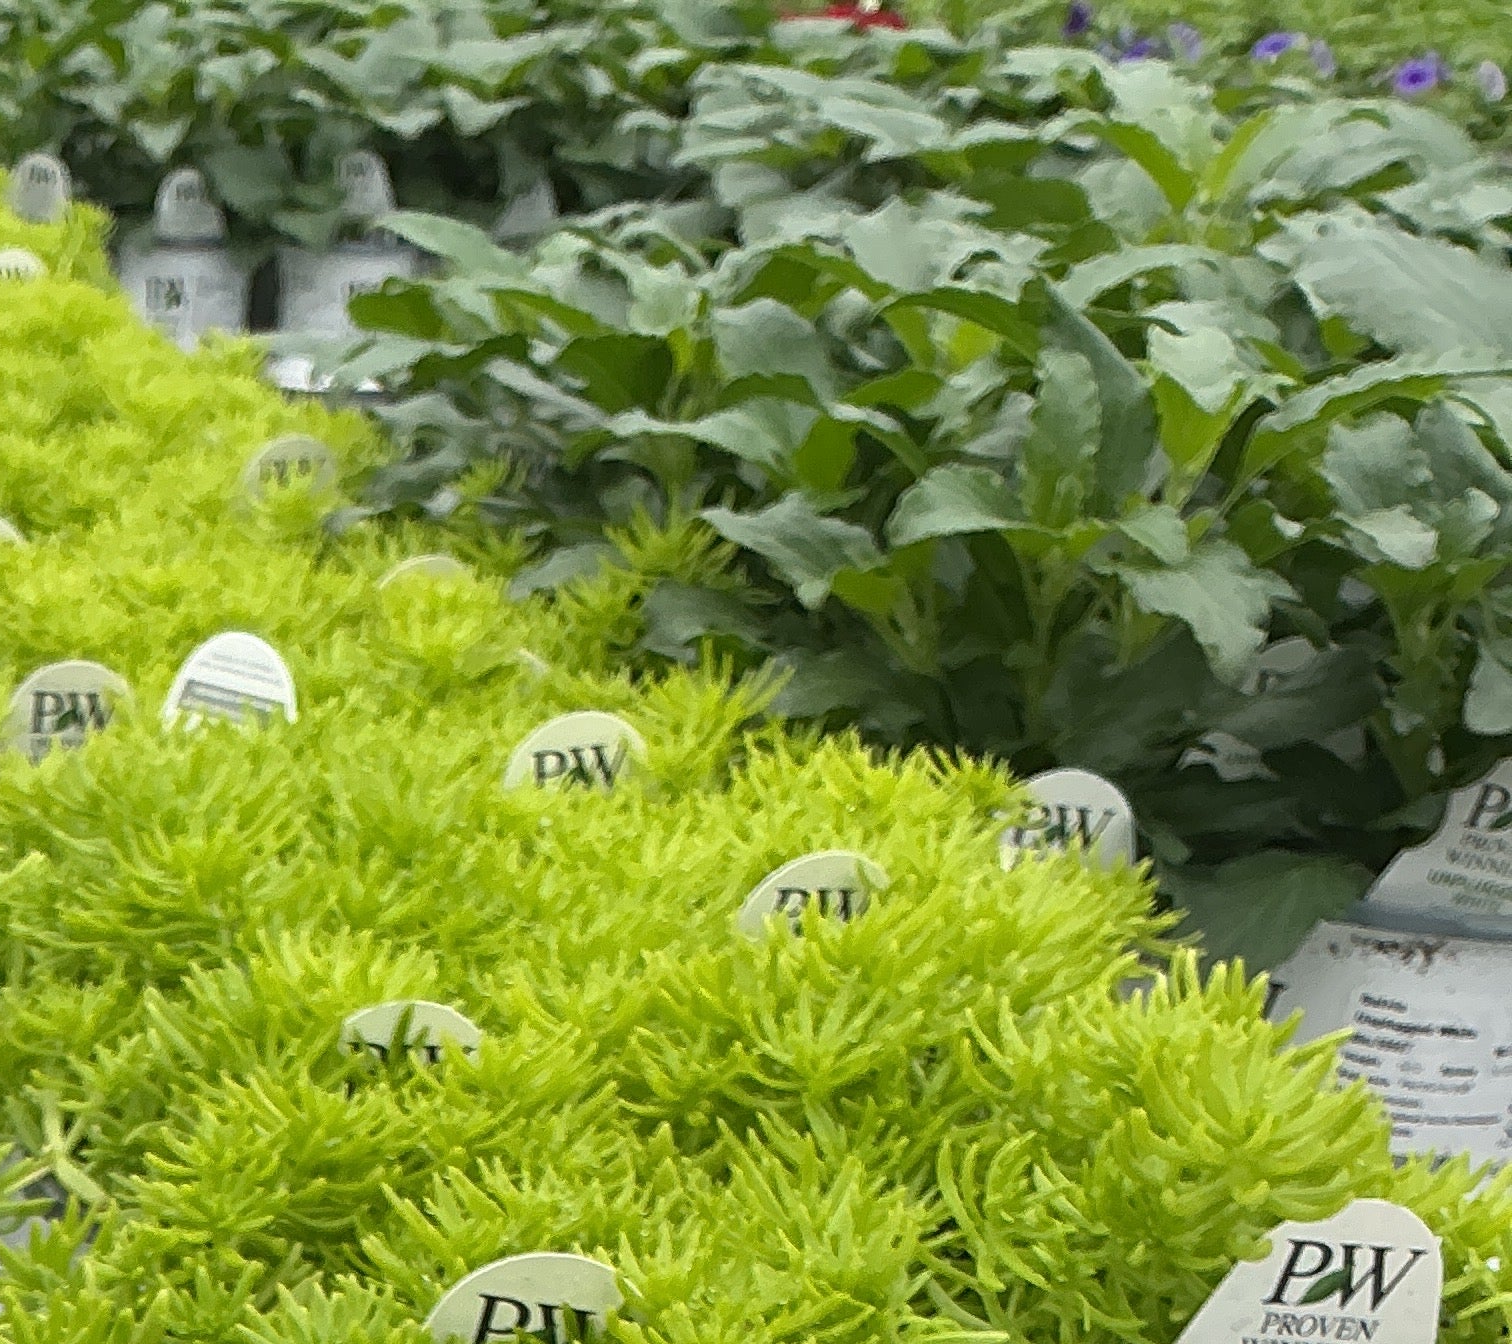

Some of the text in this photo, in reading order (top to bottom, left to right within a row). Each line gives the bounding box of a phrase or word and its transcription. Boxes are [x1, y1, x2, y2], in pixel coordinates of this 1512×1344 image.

[1462, 782, 1512, 829] P
[1260, 1238, 1428, 1311] PW
[1258, 1311, 1381, 1343] PROVEN
